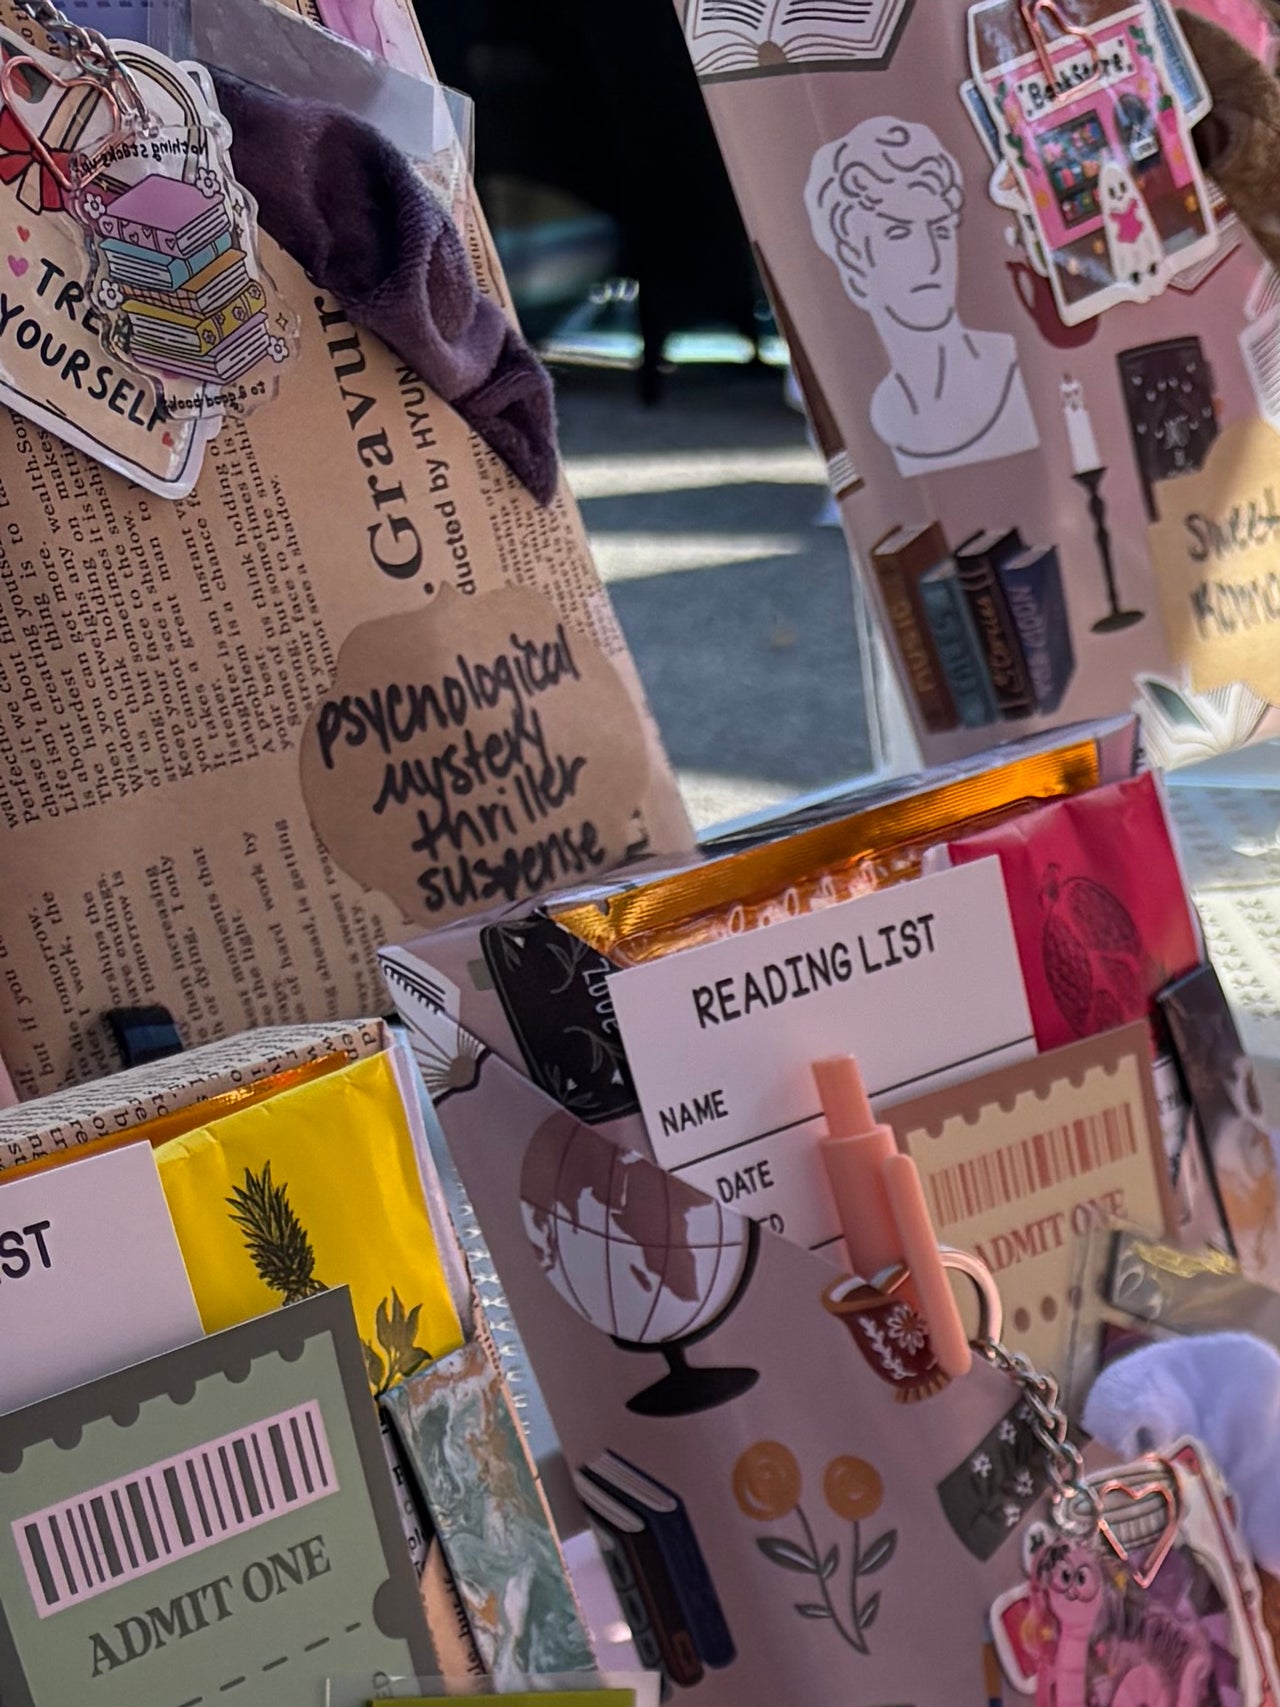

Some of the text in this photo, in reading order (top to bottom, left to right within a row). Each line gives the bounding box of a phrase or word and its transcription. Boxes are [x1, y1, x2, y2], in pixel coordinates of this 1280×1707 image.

[426, 457, 450, 495] by
[372, 706, 548, 815] mystery
[411, 752, 590, 864] thriller
[691, 939, 855, 1030] READING
[862, 913, 939, 976] LIST
[658, 1088, 730, 1138] NAME
[716, 1159, 775, 1204] DATE
[970, 1186, 1128, 1276] ADMIT ONE
[87, 1533, 333, 1677] ADMIT ONE
